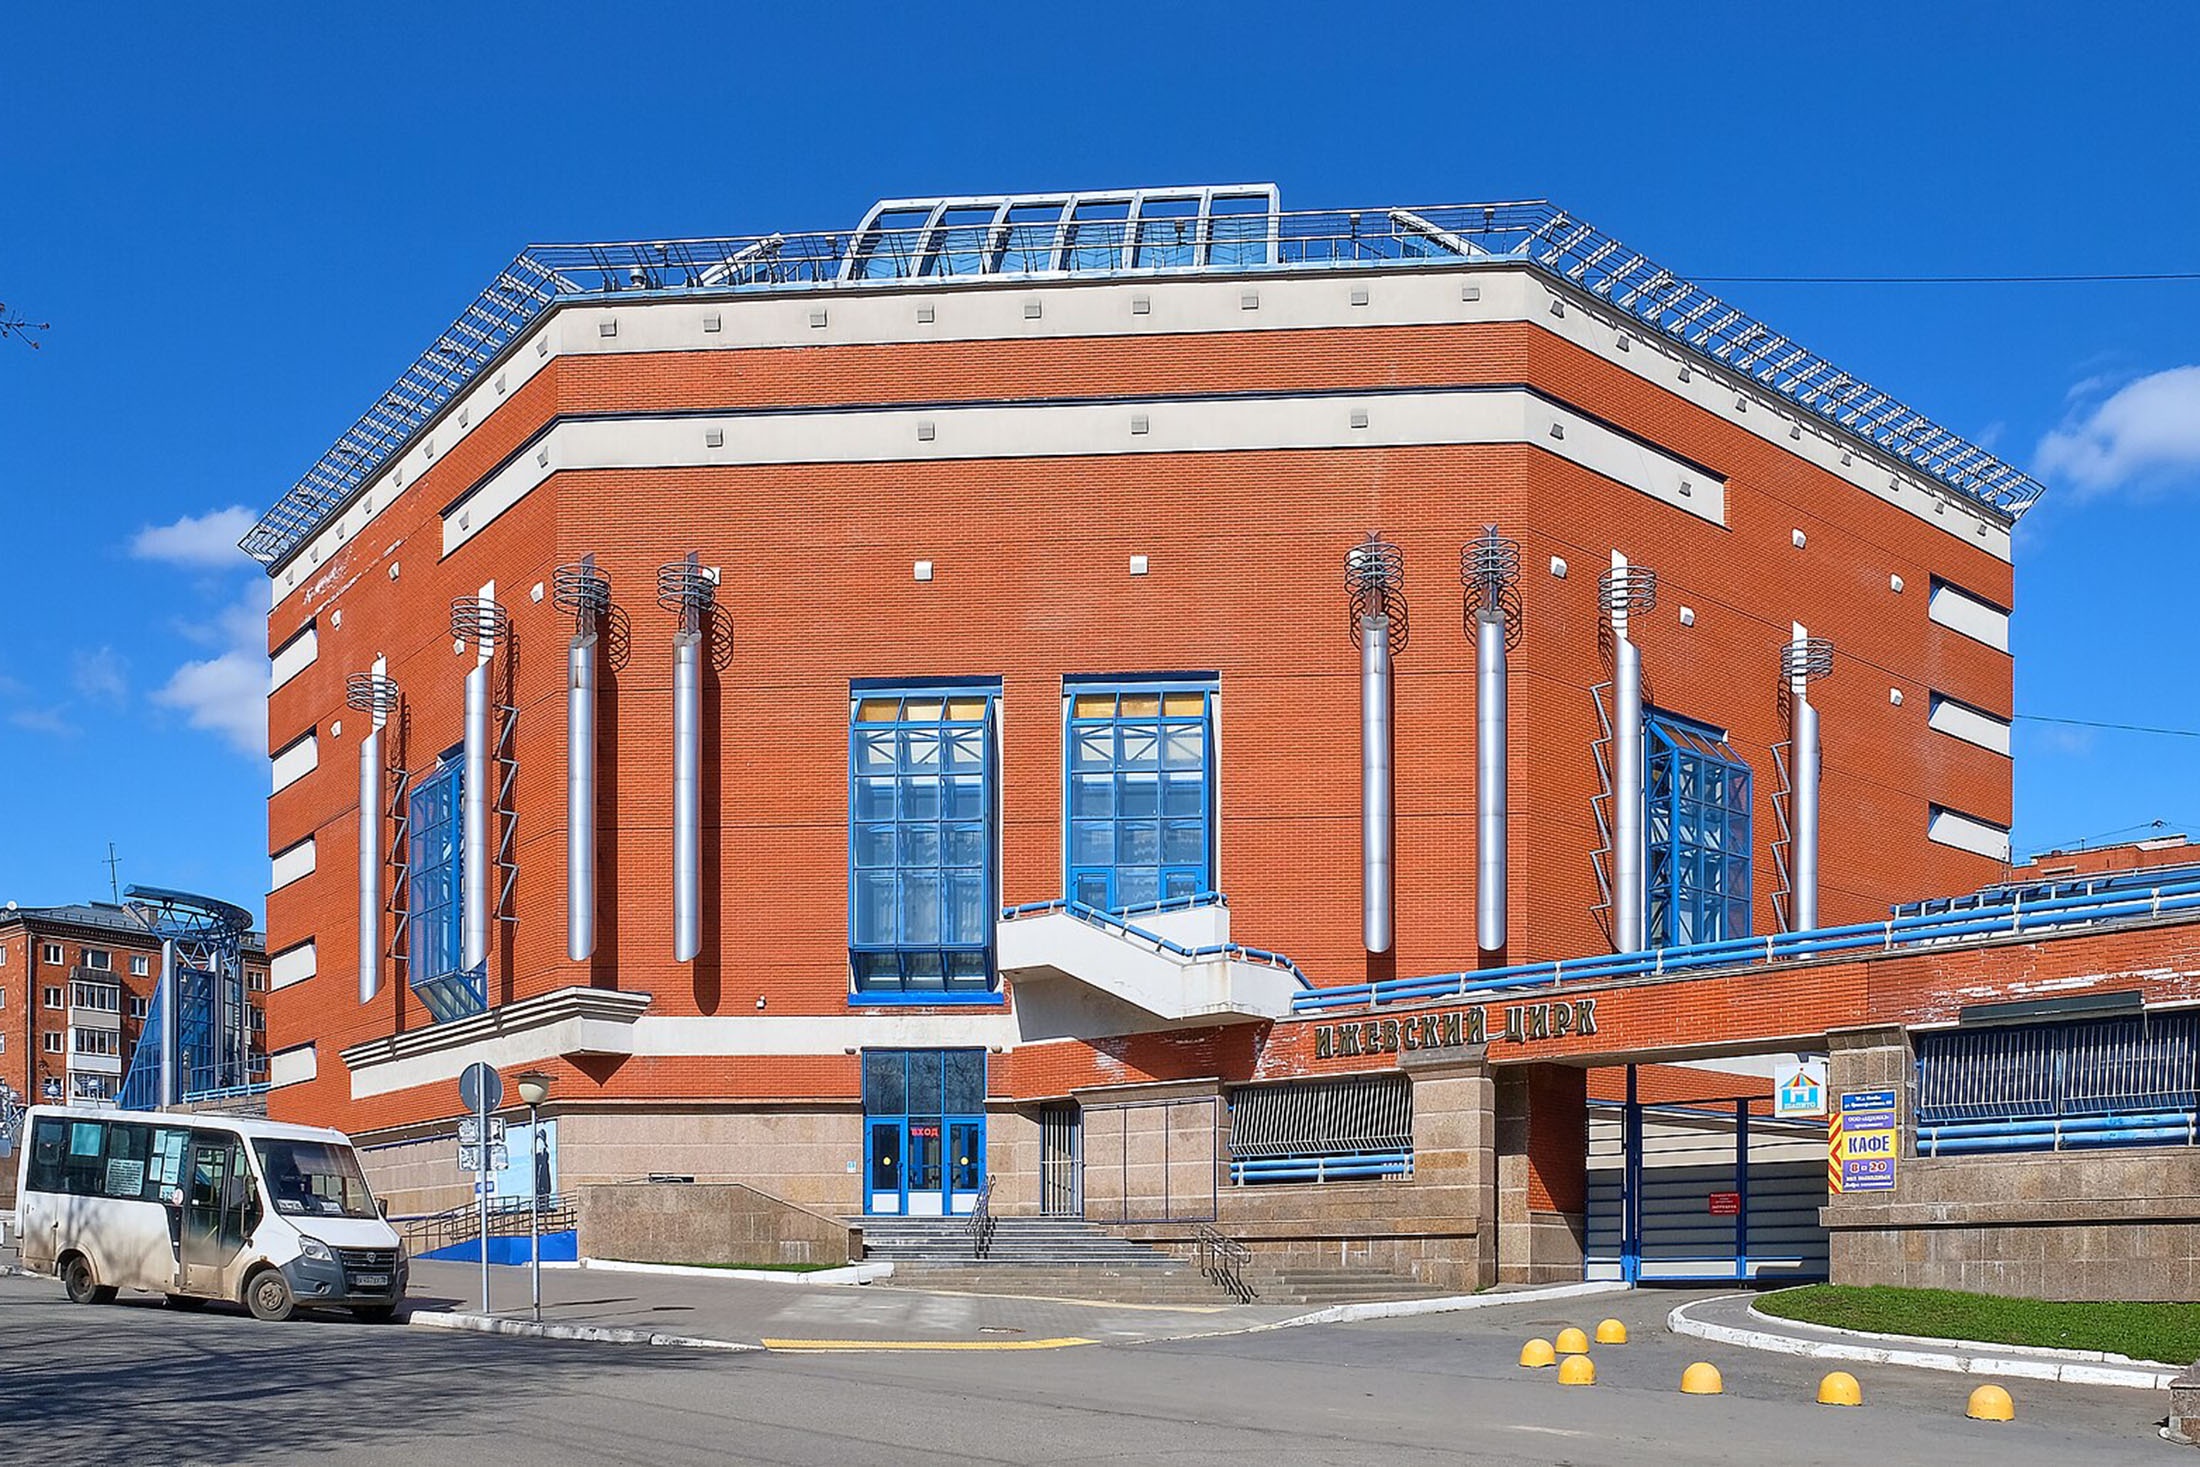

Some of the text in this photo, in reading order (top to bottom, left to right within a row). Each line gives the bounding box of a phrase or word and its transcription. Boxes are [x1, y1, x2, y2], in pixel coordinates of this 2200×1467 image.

[1314, 999, 1598, 1059] ИЖЕВСКИЙ ЦИРК
[1848, 1135, 1890, 1154] КАФЕ
[1850, 1162, 1860, 1173] 8
[1869, 1161, 1887, 1173] 20
